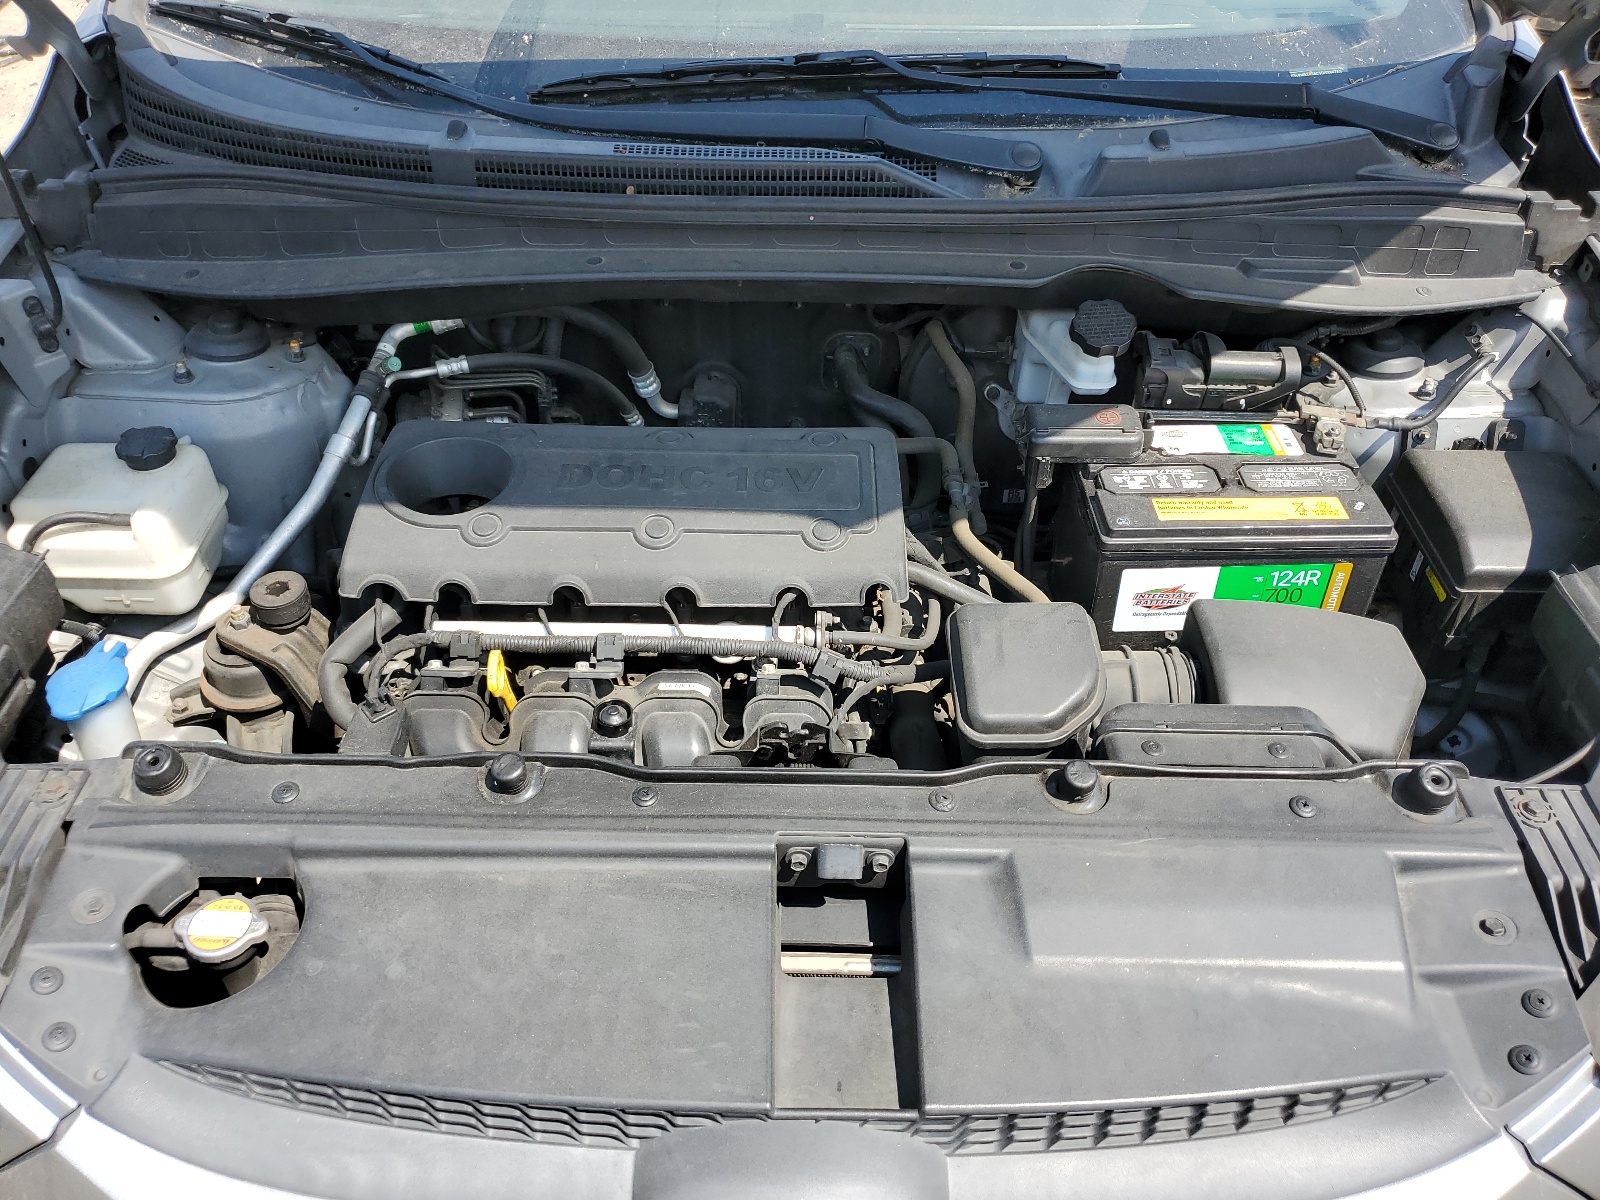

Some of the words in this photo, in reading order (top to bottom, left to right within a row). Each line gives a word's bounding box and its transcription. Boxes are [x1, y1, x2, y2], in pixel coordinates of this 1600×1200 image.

[556, 463, 714, 492] DOHC
[726, 466, 825, 493] 16V
[1270, 570, 1321, 588] 124R
[1133, 592, 1197, 600] INTERSTATE
[1133, 598, 1190, 606] BATTERIES
[1264, 588, 1303, 604] 700
